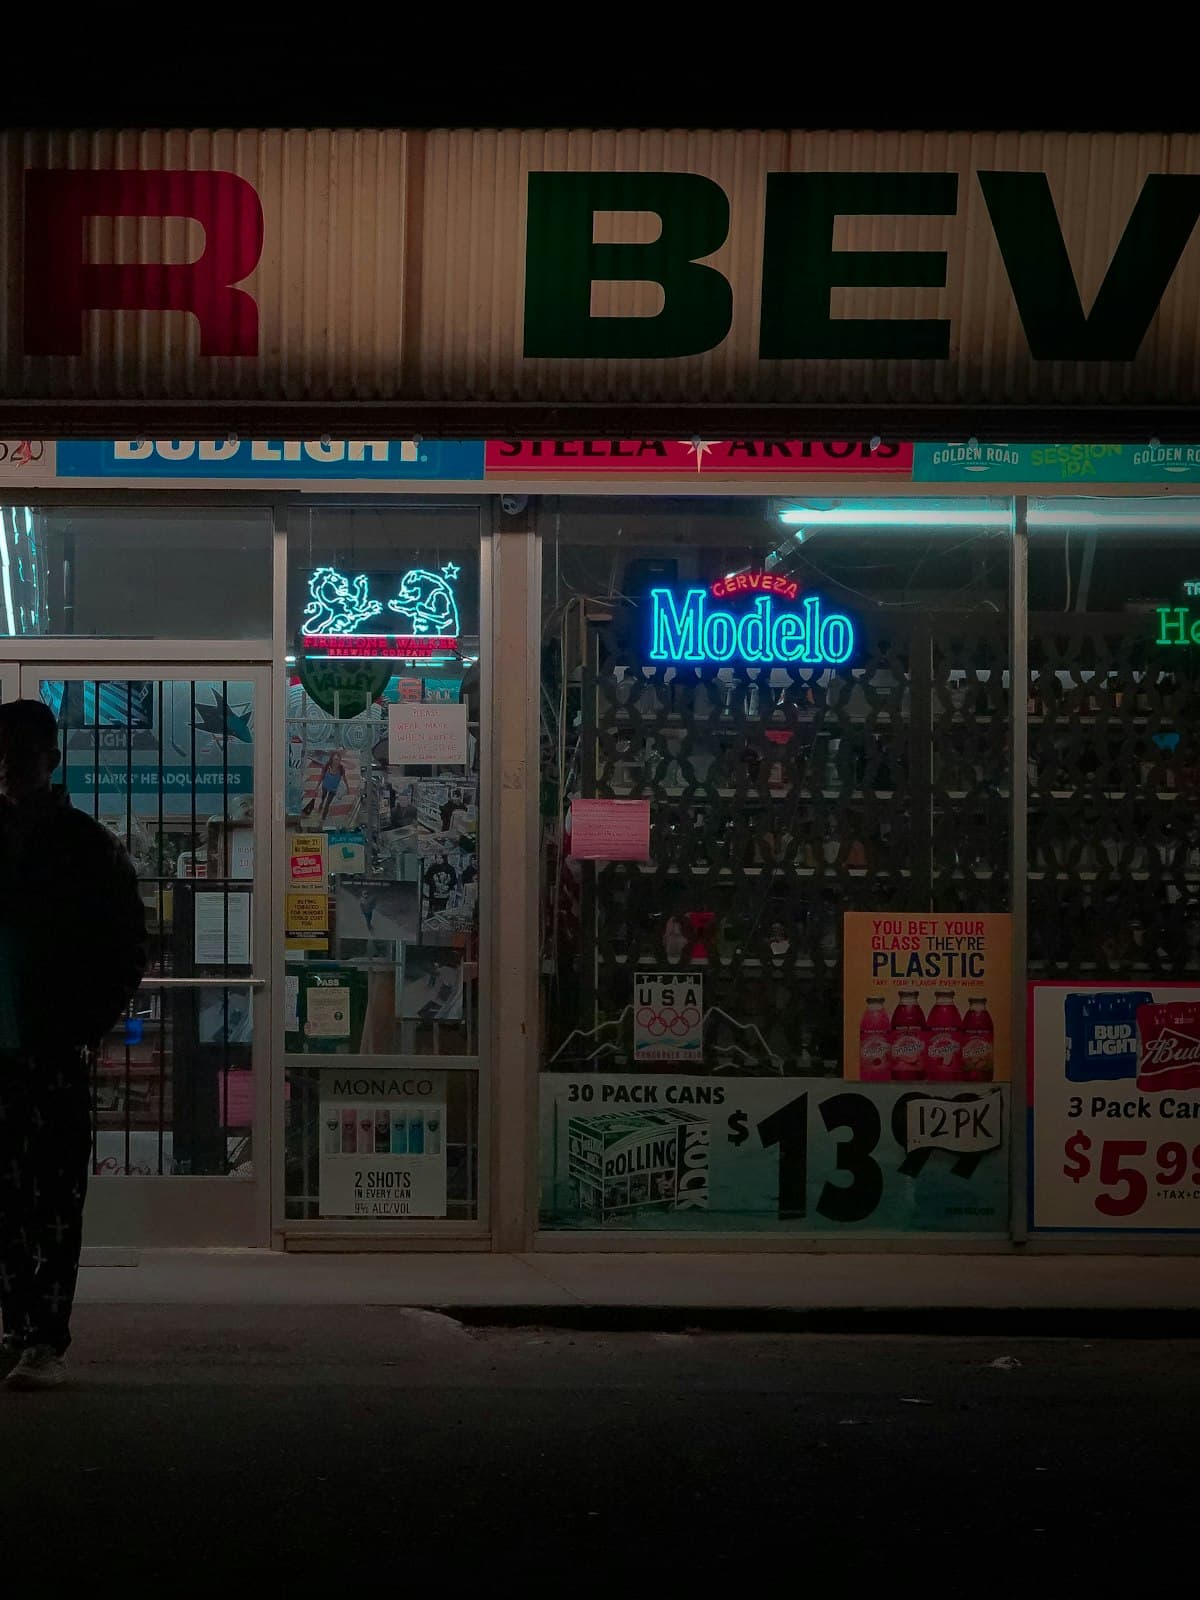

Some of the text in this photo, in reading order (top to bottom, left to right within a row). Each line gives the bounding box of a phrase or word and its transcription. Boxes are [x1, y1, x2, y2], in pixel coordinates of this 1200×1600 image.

[523, 170, 1200, 361] BEV
[933, 443, 1183, 467] GOLDEN ROAD SESSION GOLDEN
[1062, 461, 1096, 478] IPA
[711, 574, 800, 598] CERVEZA
[650, 588, 854, 664] Modelo
[872, 920, 985, 936] YOU BET YOUR
[871, 936, 985, 951] GLASS THEY'RE
[872, 951, 985, 978] PLASTIC
[640, 989, 697, 1006] USA
[1094, 1024, 1132, 1040] BUD
[1088, 1038, 1137, 1056] LIGHT
[333, 1079, 433, 1096] MONACO
[568, 1083, 725, 1105] 30 PACK CANS
[1067, 1097, 1083, 1118] 3
[1091, 1096, 1152, 1119] Pack
[604, 1137, 677, 1178] ROLLING
[354, 1171, 412, 1189] 2 SHOTS
[354, 1188, 412, 1199] IN EVERY CAN
[371, 1202, 412, 1214] ALC/VOL
